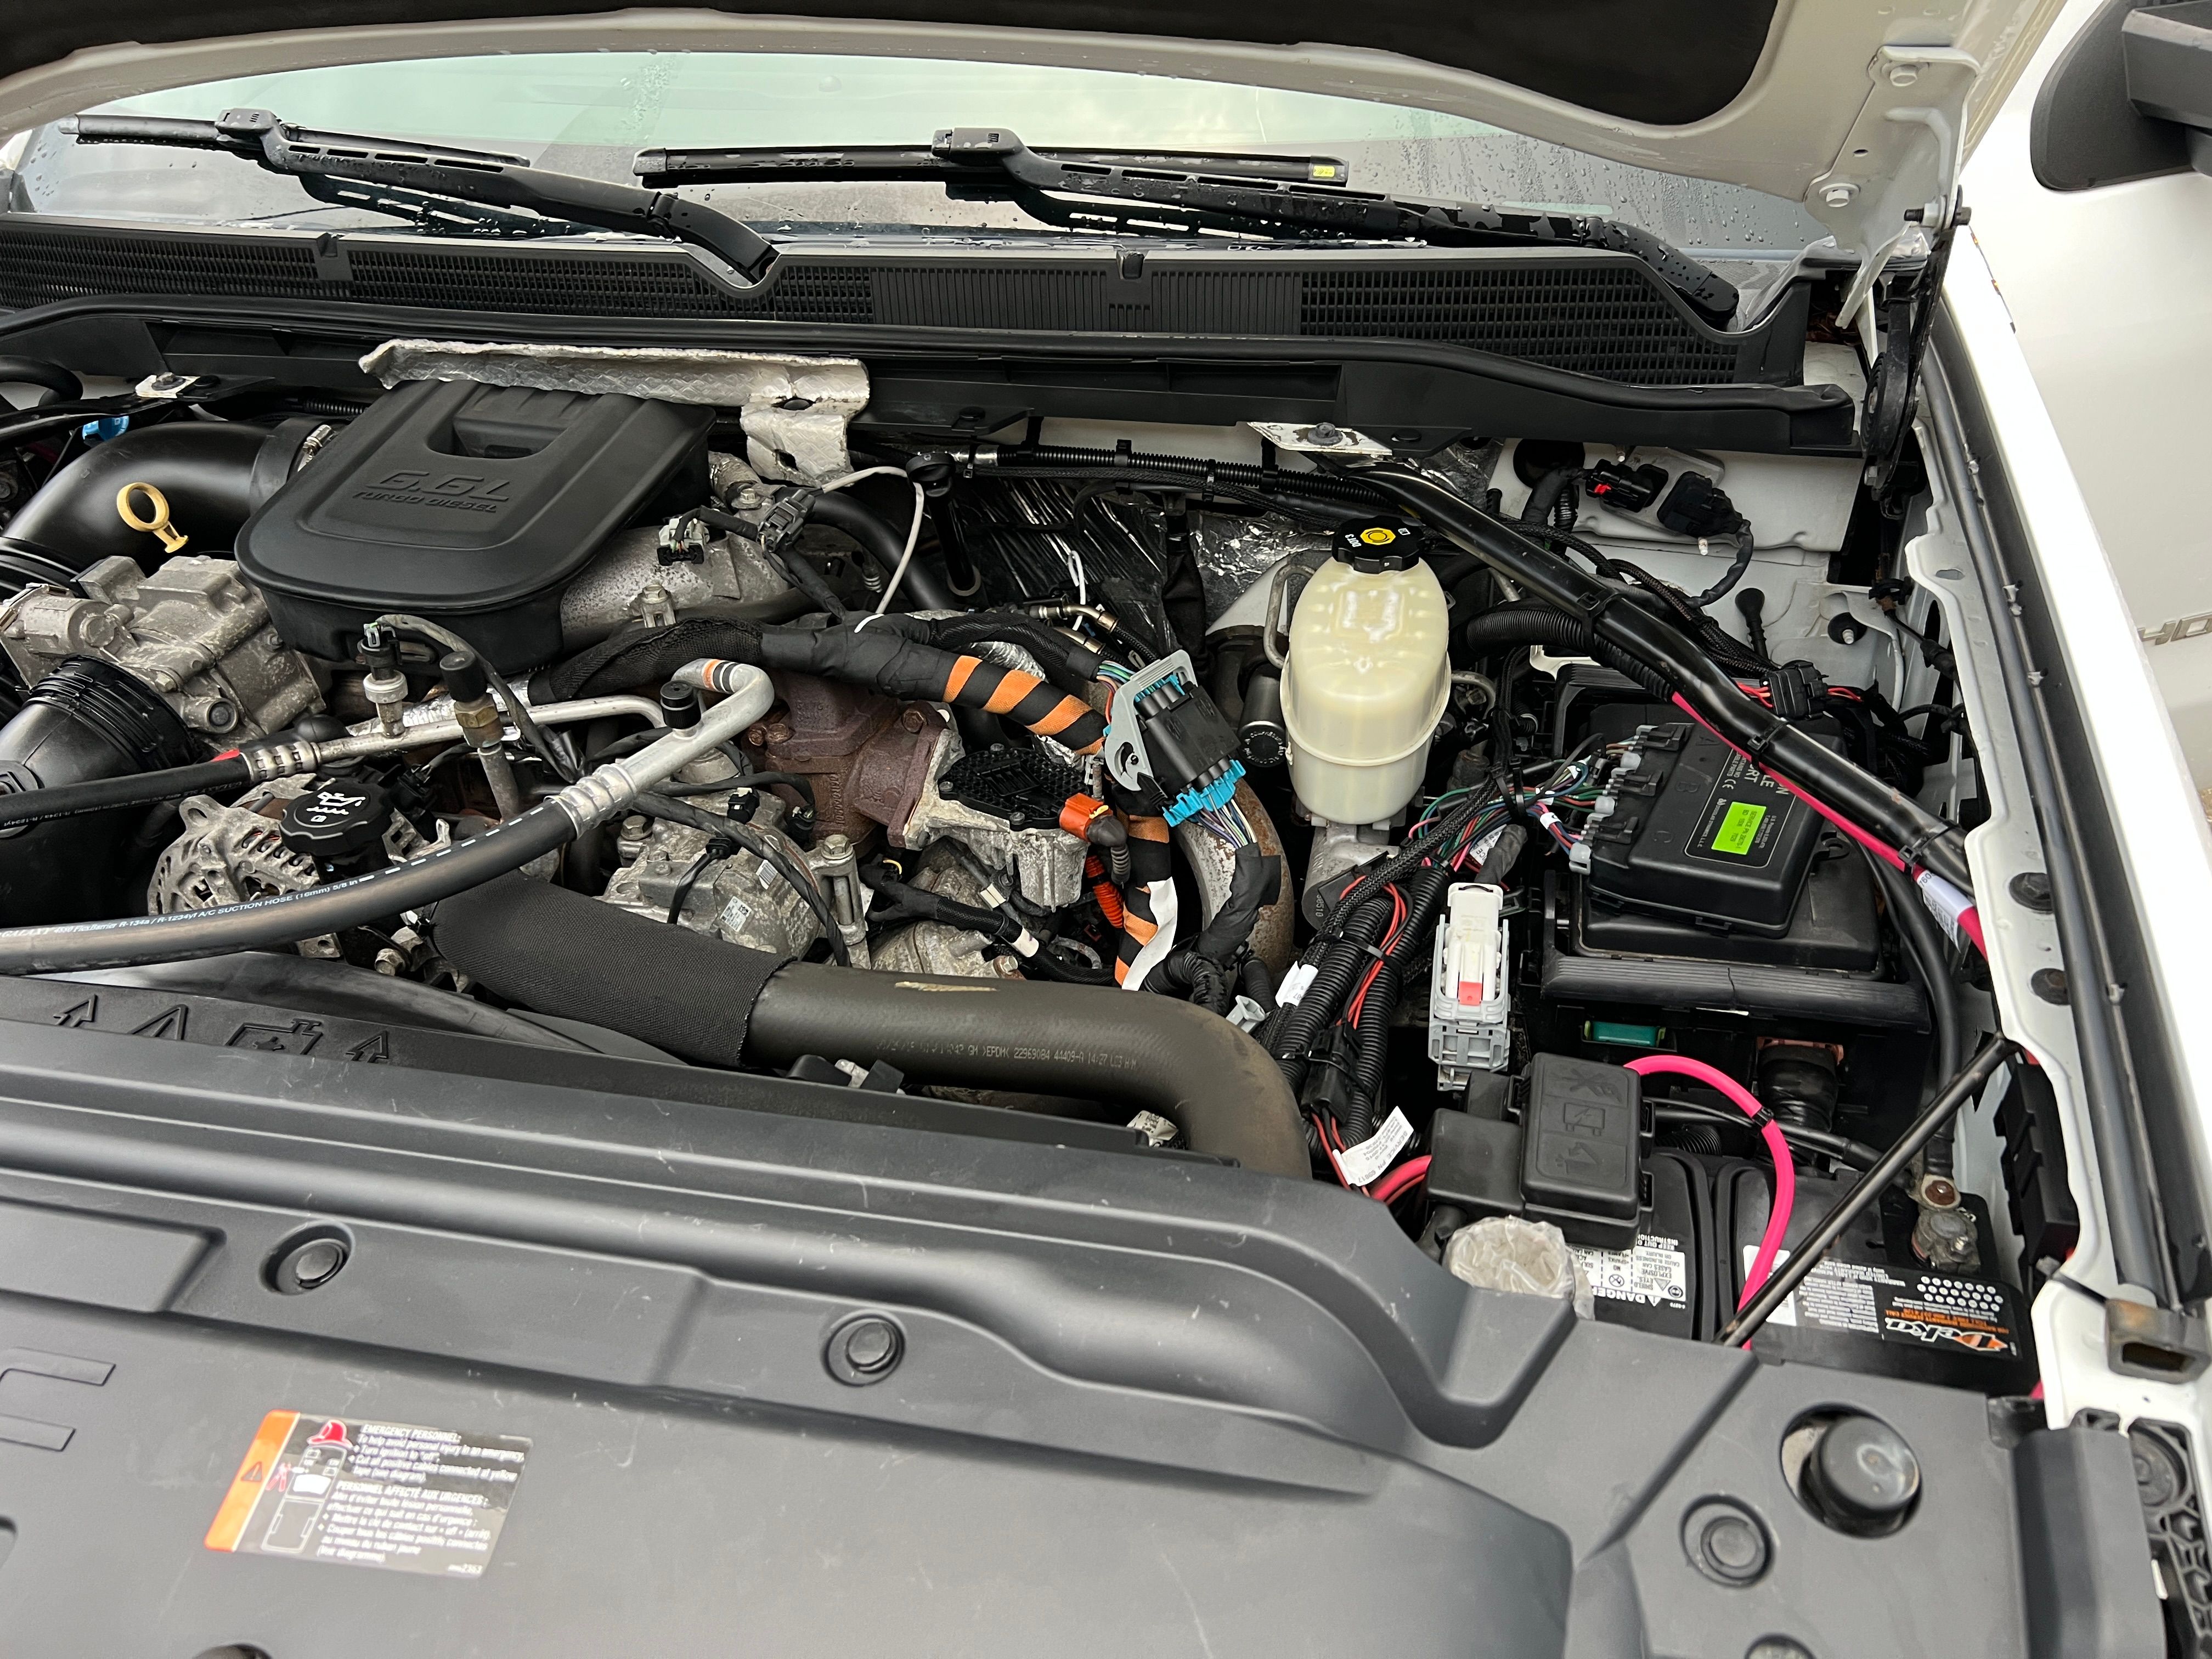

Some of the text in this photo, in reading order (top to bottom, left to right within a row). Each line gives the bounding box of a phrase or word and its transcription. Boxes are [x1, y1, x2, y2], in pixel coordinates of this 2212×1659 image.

[365, 470, 510, 502] 6.6L
[353, 492, 497, 513] TURBO DIESEL
[119, 919, 149, 928] R-134a
[198, 909, 216, 918] A/C
[217, 901, 263, 915] SUCTION
[263, 895, 294, 907] HOSE
[295, 887, 331, 901] (16mm)
[1013, 1047, 1050, 1060] 22969084
[1386, 1130, 1408, 1160] SERVICE
[1636, 1256, 1662, 1264] BLINDNESS
[1654, 1264, 1672, 1272] GASES
[1641, 1269, 1672, 1278] EXPLOSIVE
[363, 1425, 462, 1443] EMERGENCY PERSONNEL:
[361, 1446, 379, 1455] Turn
[379, 1447, 409, 1459] ignition
[369, 1436, 385, 1446] help
[386, 1438, 407, 1447] avoid
[407, 1441, 439, 1452] personal
[439, 1443, 461, 1455] injury
[481, 1449, 525, 1462] emergency,
[356, 1456, 370, 1464] Cut
[381, 1459, 412, 1470] positive
[413, 1462, 438, 1472] cables
[438, 1464, 480, 1477] connected
[489, 1469, 517, 1482] yellow
[336, 1481, 483, 1504] PERSONNEL AFFECTÉ AUX URGENCES
